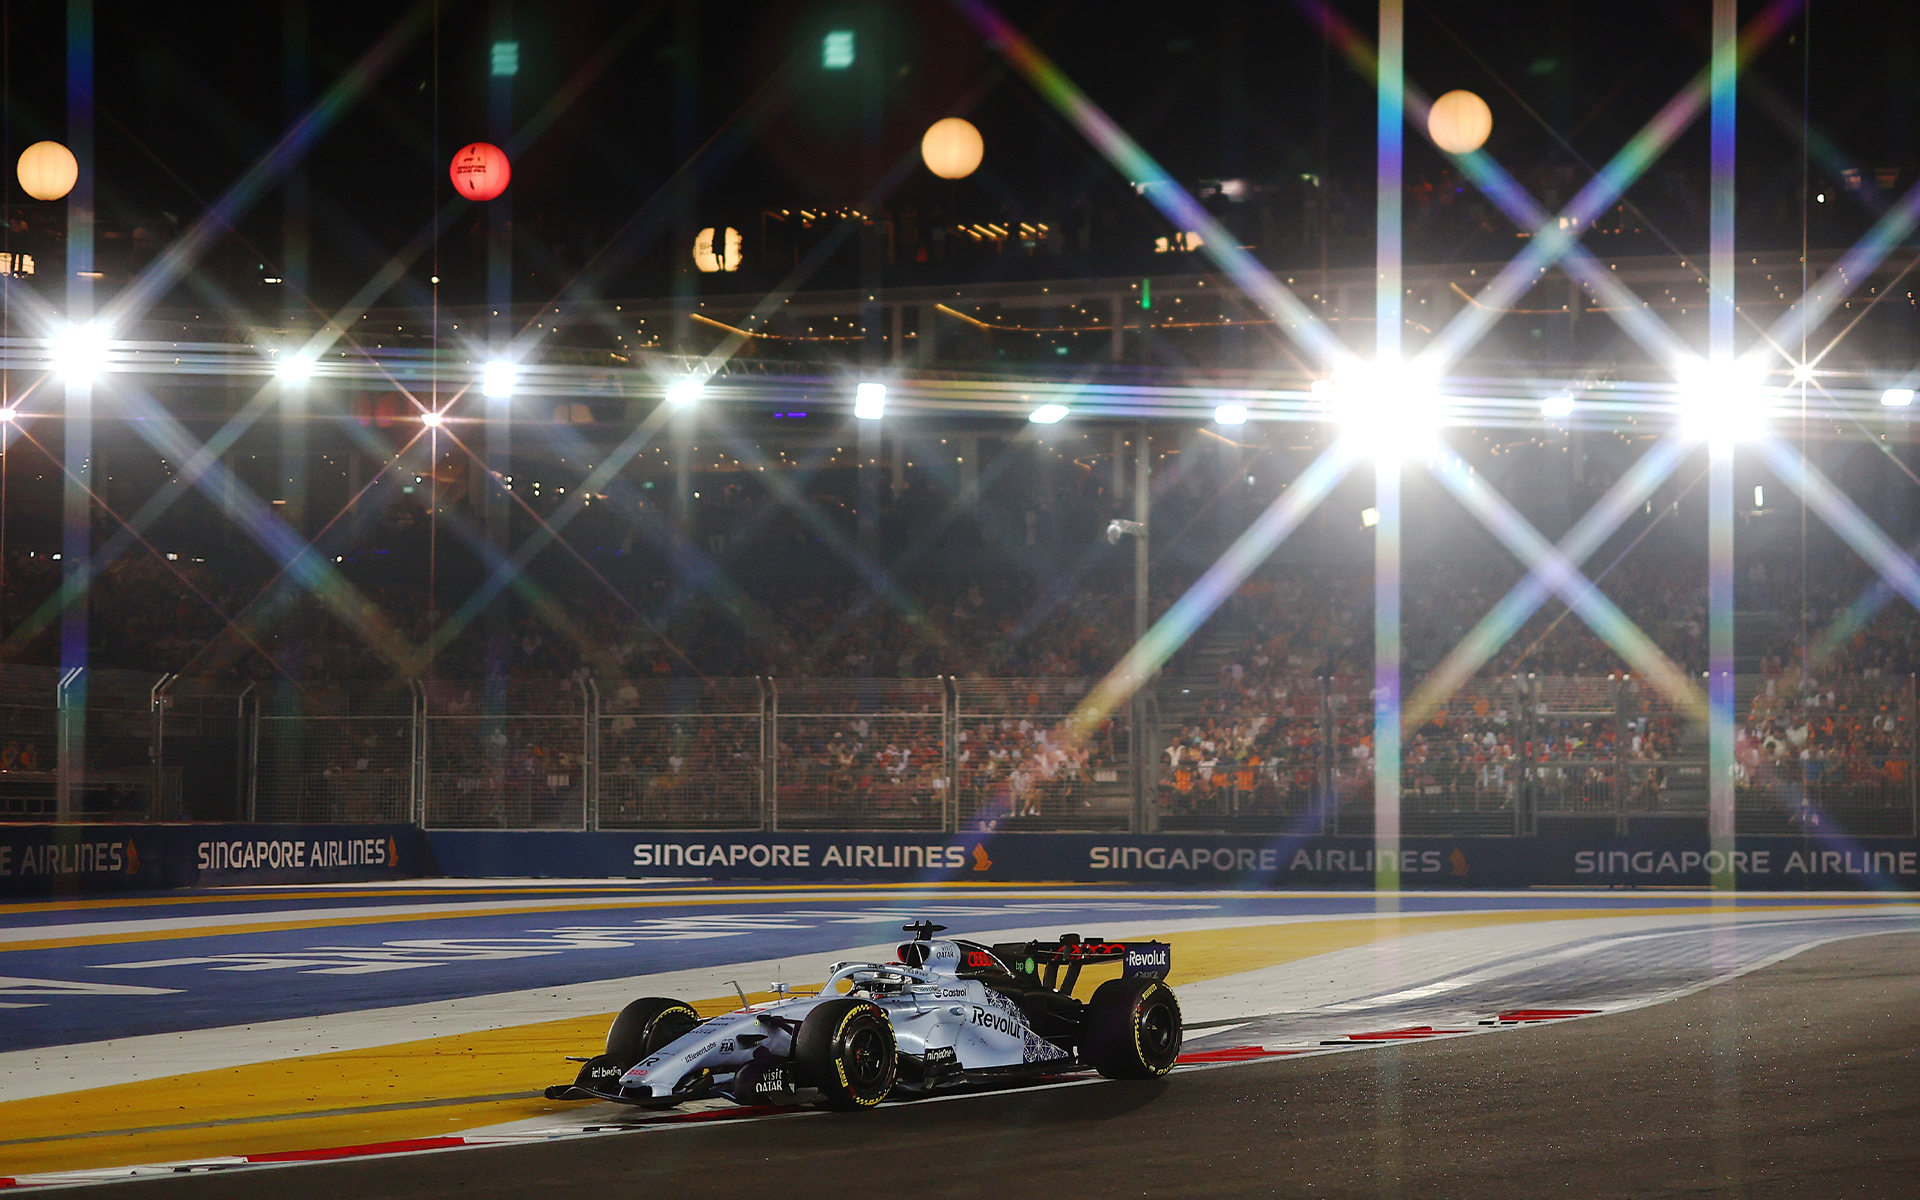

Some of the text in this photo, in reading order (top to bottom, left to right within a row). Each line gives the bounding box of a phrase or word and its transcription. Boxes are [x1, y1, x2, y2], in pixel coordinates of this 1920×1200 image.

[20, 842, 123, 875] AIRLINES
[197, 838, 386, 869] SINGAPORE AIRLINES
[633, 843, 966, 868] SINGAPORE AIRLINES
[1089, 846, 1442, 873] SINGAPORE AIRLINES
[1573, 850, 1770, 874] SINGAPORE
[936, 951, 954, 960] QATAR
[1015, 960, 1025, 972] bp
[1128, 949, 1166, 967] Revolut
[942, 988, 967, 998] Castrol
[970, 1005, 1021, 1039] Revolut
[762, 1068, 783, 1081] visit
[755, 1080, 783, 1093] QATAR
